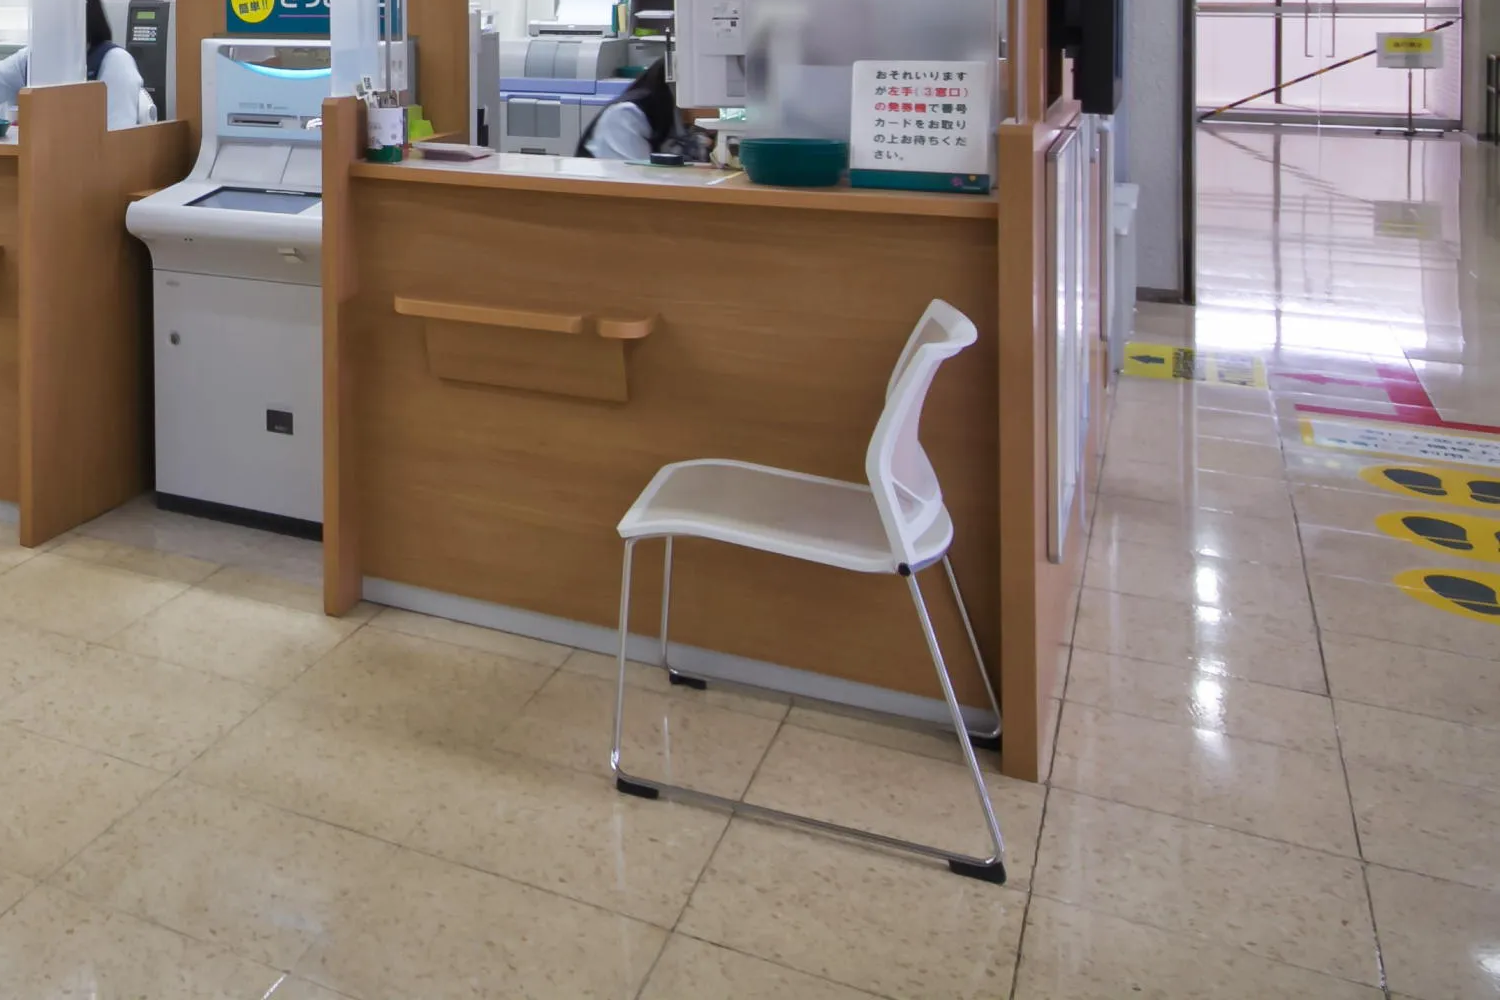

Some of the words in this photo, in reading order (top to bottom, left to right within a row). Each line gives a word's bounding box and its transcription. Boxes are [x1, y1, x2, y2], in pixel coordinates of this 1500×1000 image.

[875, 70, 968, 81] おそれいります
[874, 118, 967, 130] カードをお取り
[873, 134, 967, 147] の上お待ちくだ
[874, 150, 904, 161] さい。
